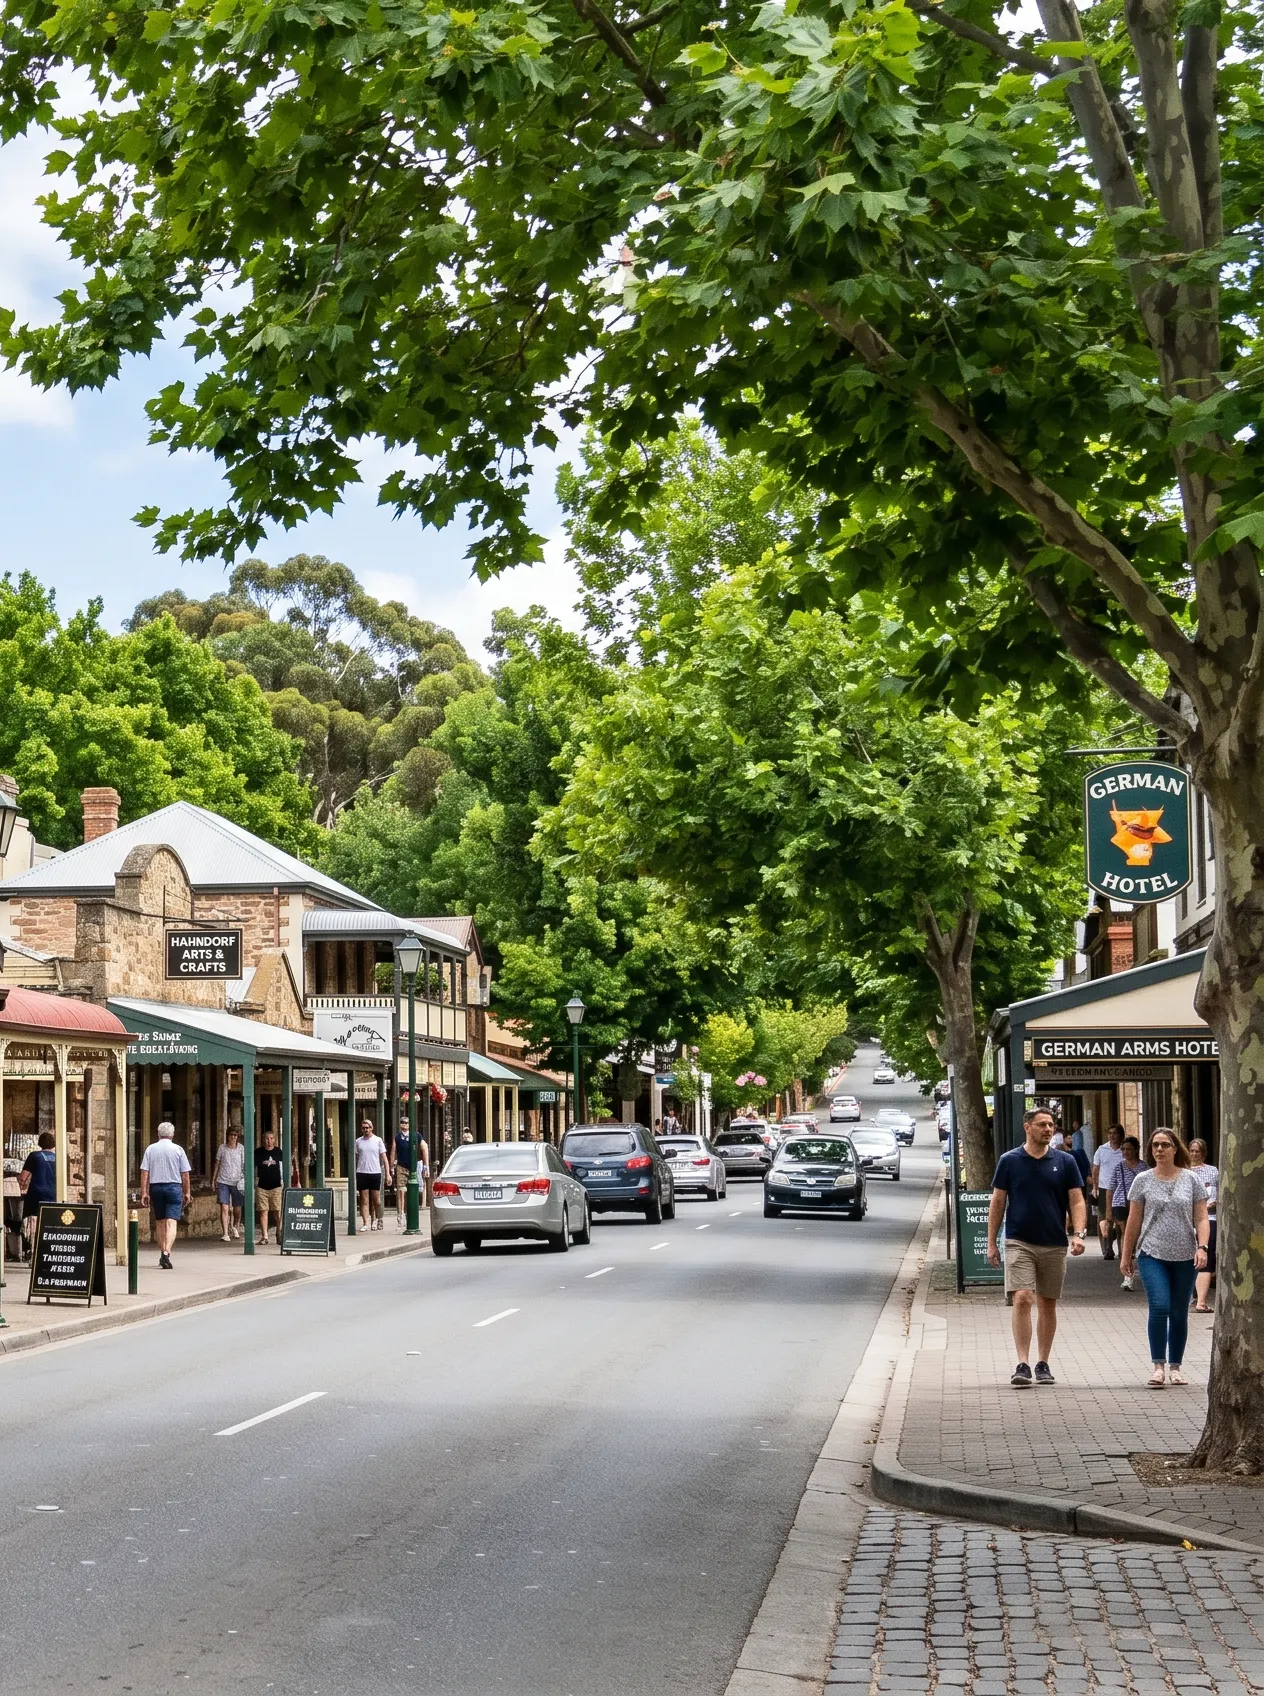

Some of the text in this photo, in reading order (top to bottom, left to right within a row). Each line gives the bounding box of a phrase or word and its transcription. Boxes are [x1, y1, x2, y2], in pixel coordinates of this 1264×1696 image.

[1089, 773, 1184, 799] GERMAN
[1100, 871, 1178, 894] HOTEL
[171, 936, 236, 947] HAHNDORF
[182, 949, 224, 959] ARTS &
[180, 962, 226, 972] CRAFTS
[1041, 1042, 1116, 1056] GERMAN
[1121, 1041, 1171, 1056] ARMS
[1175, 1041, 1220, 1055] HOTE
